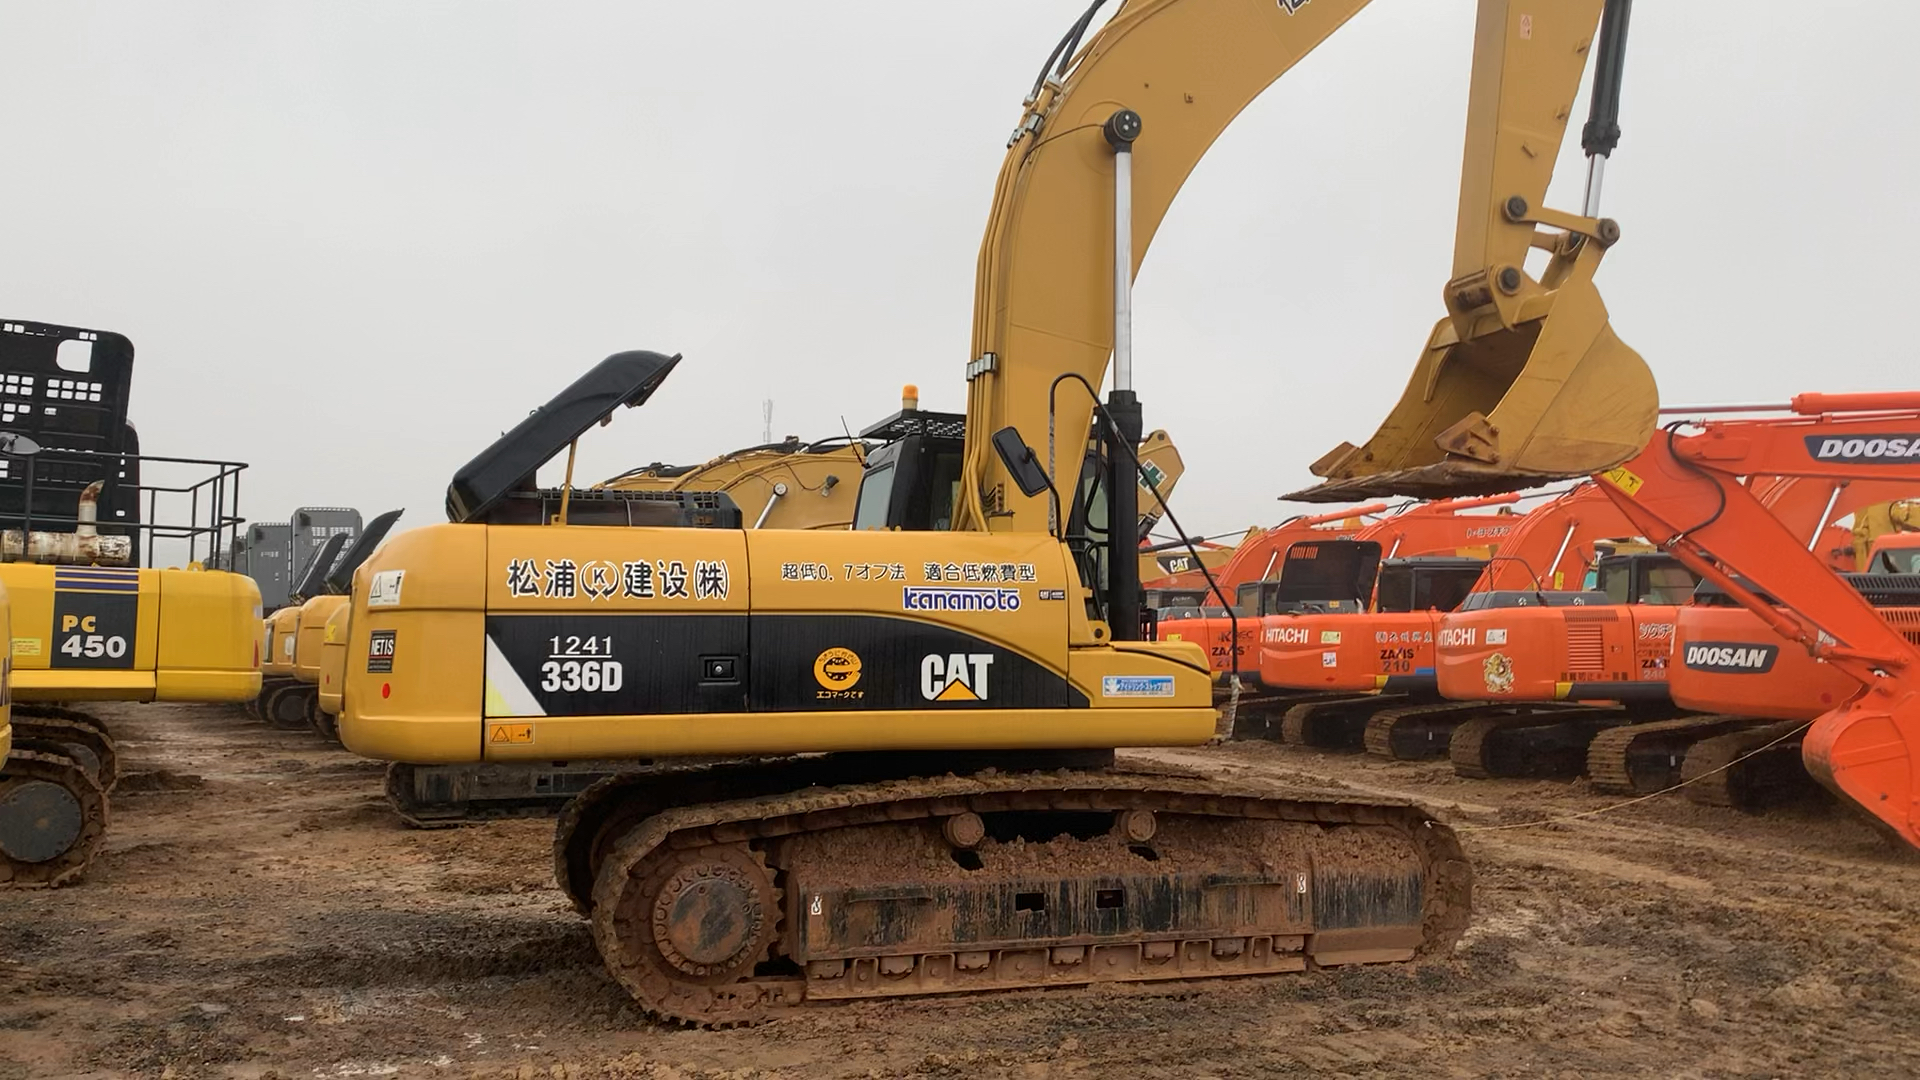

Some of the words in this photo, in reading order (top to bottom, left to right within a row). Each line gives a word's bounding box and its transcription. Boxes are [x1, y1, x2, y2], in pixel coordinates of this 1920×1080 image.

[1169, 557, 1188, 573] CAT
[903, 587, 1021, 611] kanamoto
[62, 615, 96, 632] PC
[550, 635, 612, 655] 1241
[1265, 628, 1309, 644] HITACHI
[1438, 628, 1475, 646] HITACHI
[61, 635, 126, 658] 450
[370, 639, 394, 655] NETIS
[1383, 660, 1410, 672] 210
[1686, 645, 1767, 668] DOOSAN
[541, 660, 623, 692] 336D
[921, 654, 994, 700] CAT
